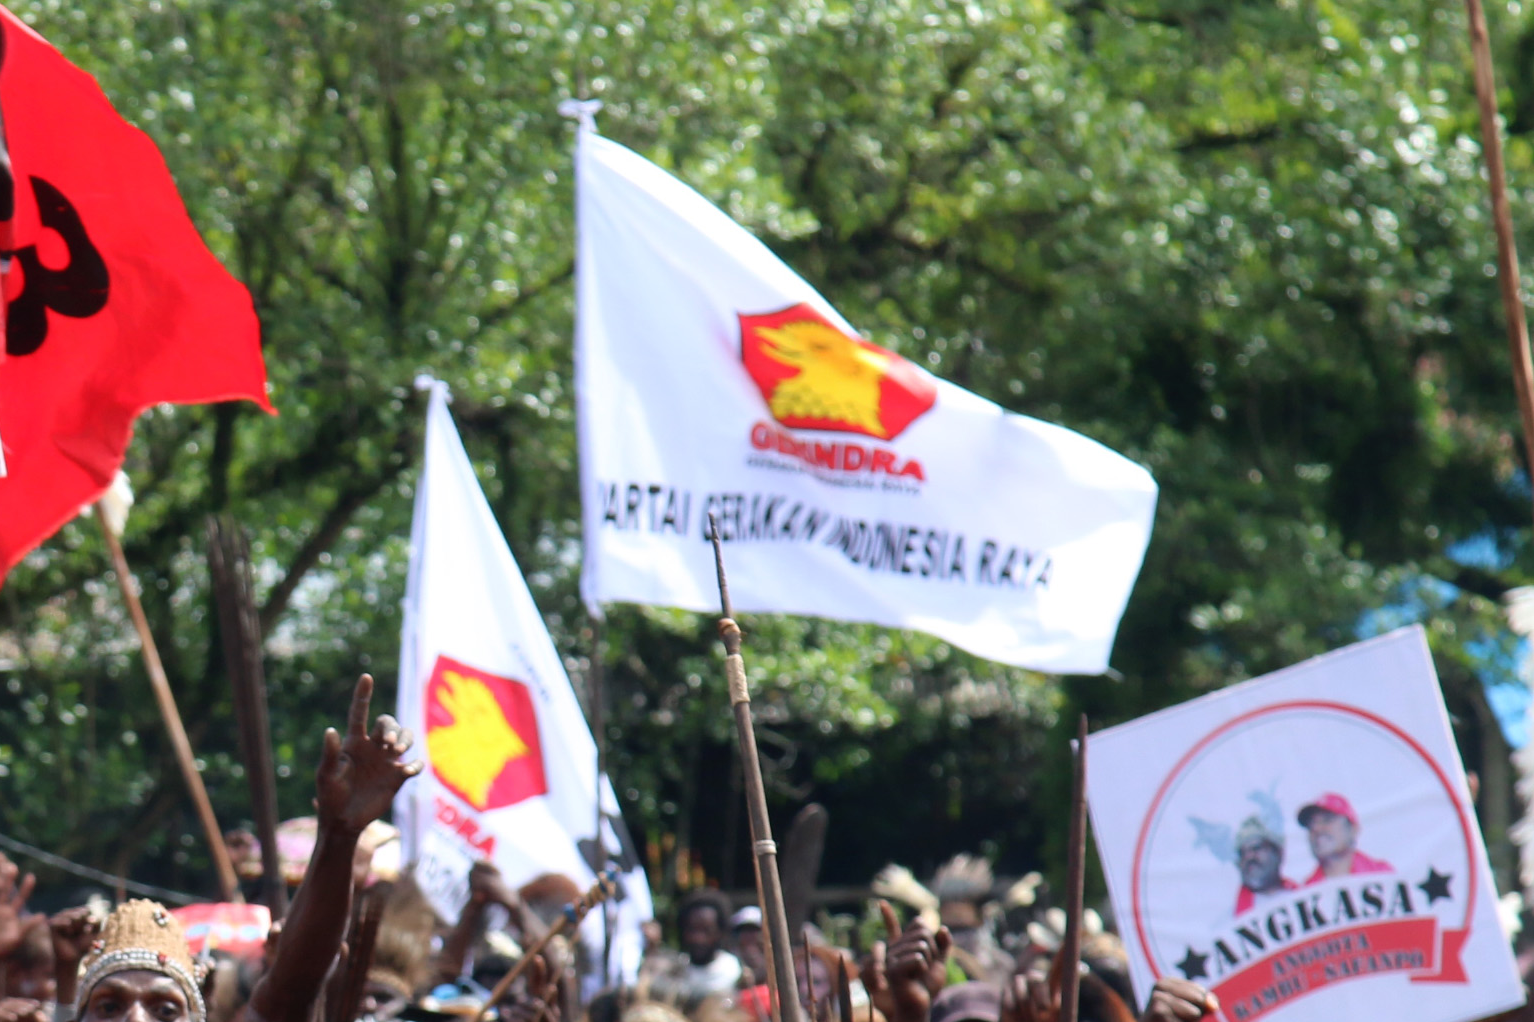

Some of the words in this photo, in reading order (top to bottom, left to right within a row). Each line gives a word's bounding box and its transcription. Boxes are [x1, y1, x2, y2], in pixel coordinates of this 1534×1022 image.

[599, 483, 691, 535] ARTAI
[977, 536, 1054, 591] RAYA
[1214, 882, 1415, 977] ANGKASA
